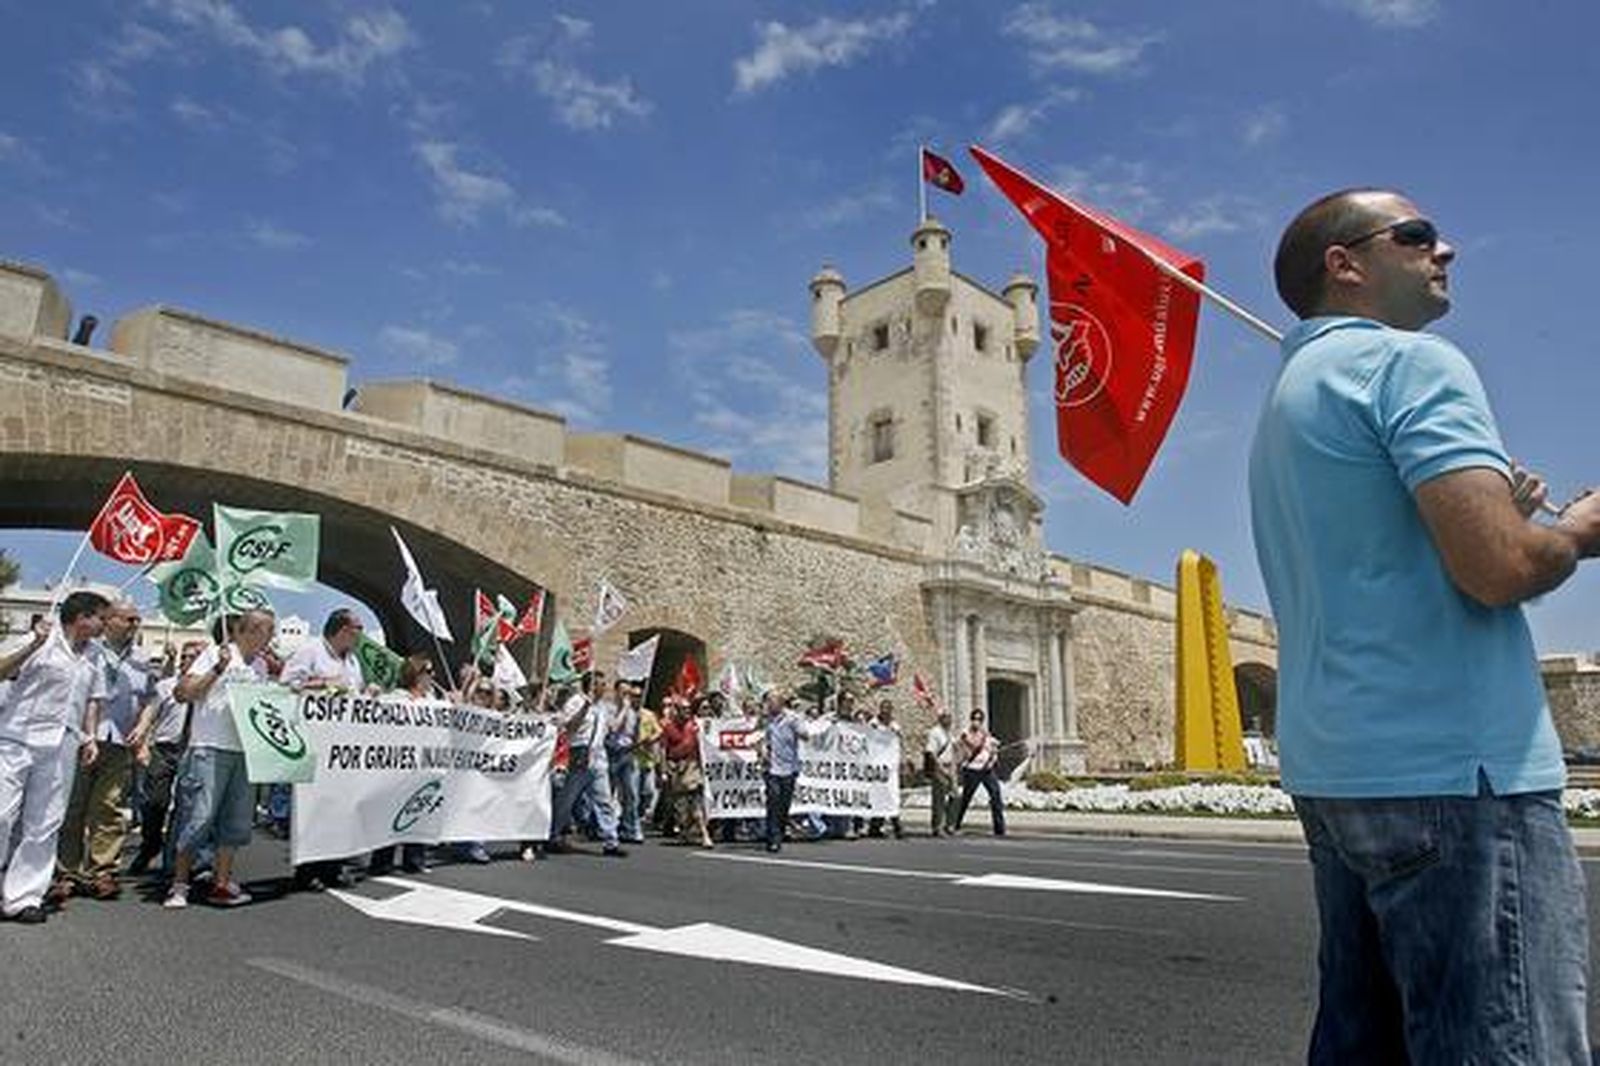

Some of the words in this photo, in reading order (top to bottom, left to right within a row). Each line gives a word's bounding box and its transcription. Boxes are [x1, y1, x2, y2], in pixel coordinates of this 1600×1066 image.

[303, 695, 348, 721] CSI-F
[350, 699, 411, 726] RECHAZA
[413, 705, 433, 727] LAS
[328, 745, 361, 770] POR
